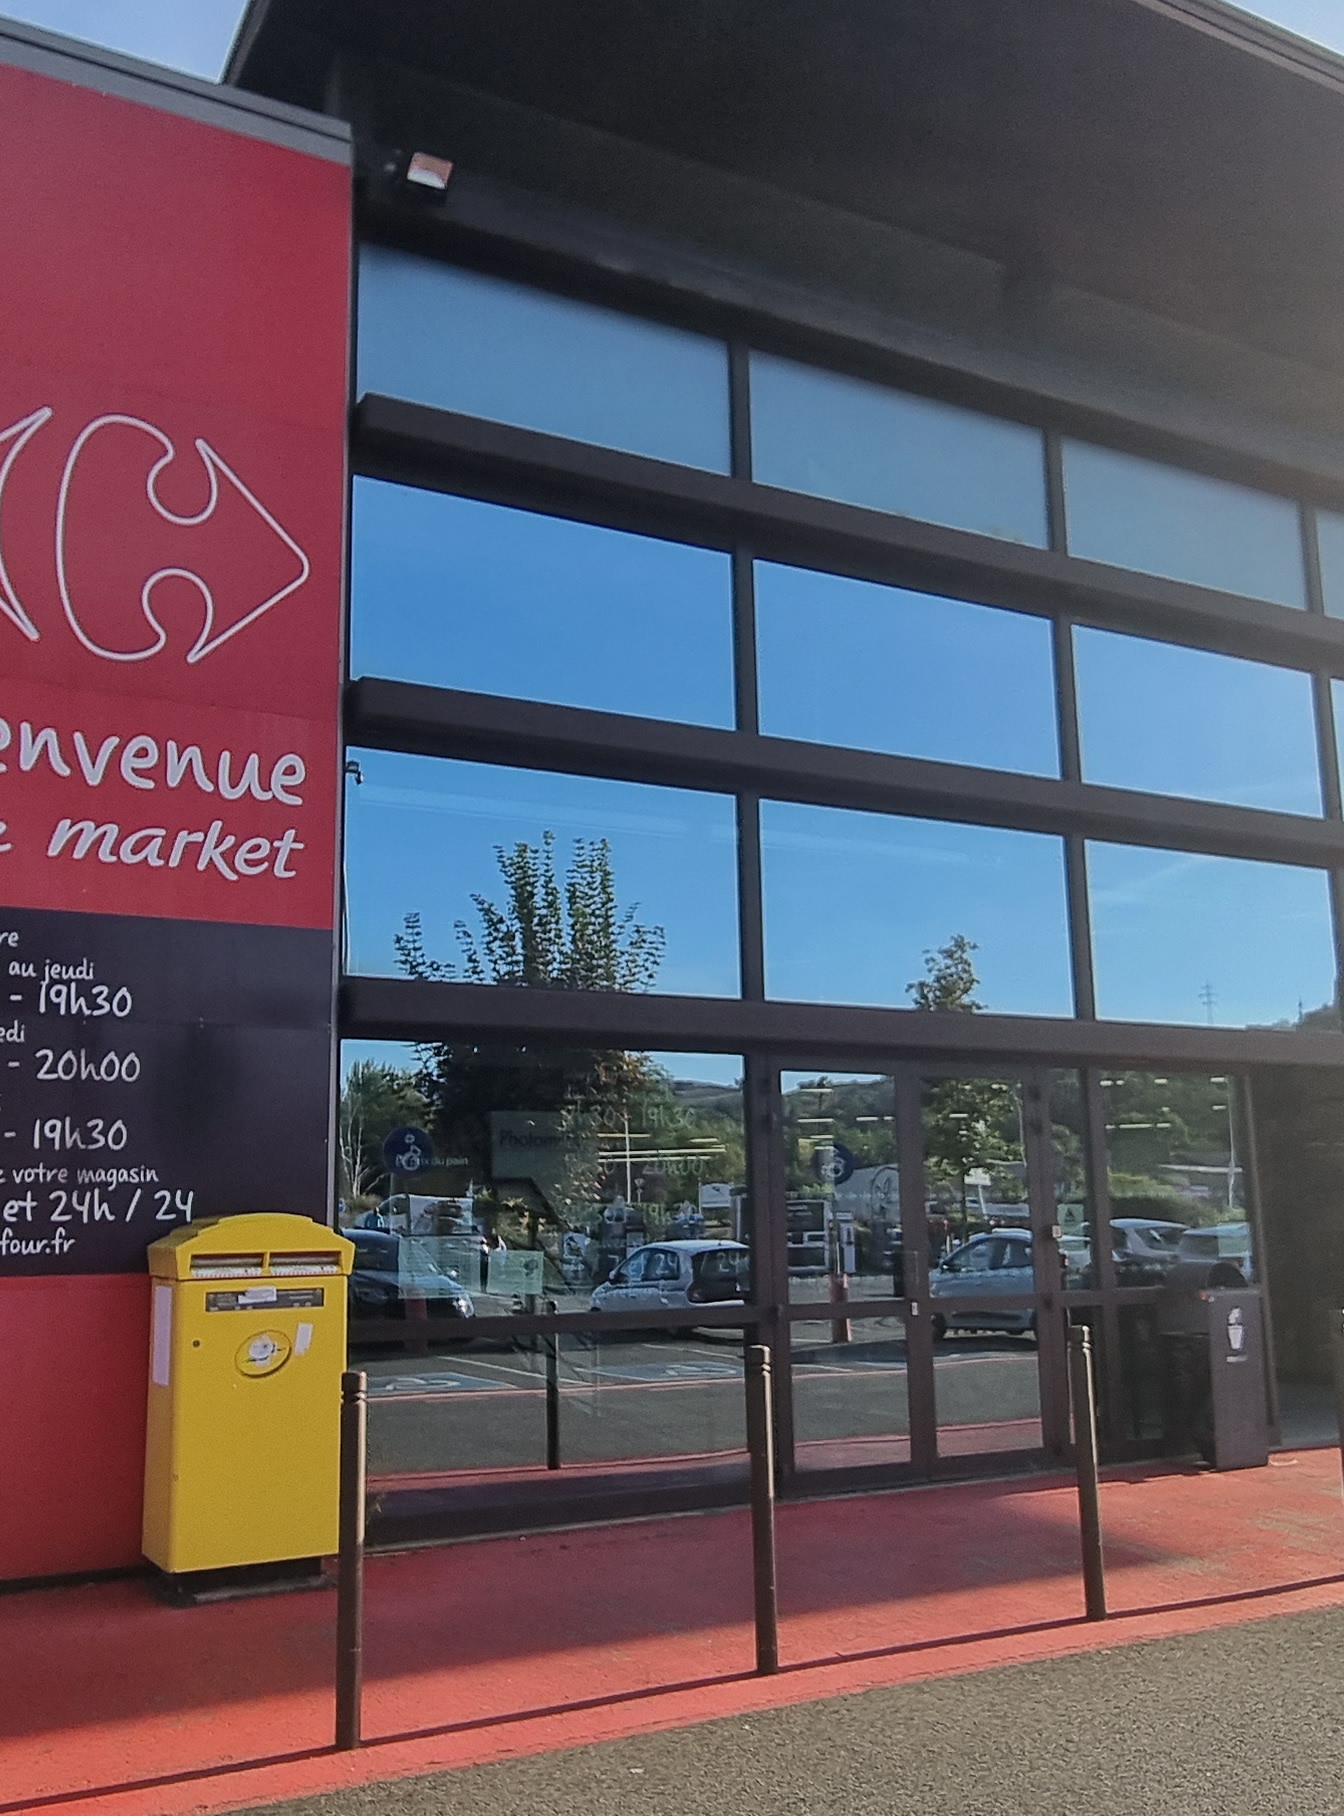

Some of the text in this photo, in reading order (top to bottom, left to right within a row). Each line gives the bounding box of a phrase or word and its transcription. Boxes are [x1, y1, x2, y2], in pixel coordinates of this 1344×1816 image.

[47, 818, 305, 881] market
[8, 960, 37, 979] au
[43, 957, 95, 984] jeudi
[39, 983, 133, 1017] 19h30
[34, 1048, 141, 1082] 20h00
[32, 1118, 128, 1151] 19h30
[12, 1164, 69, 1184] votre
[76, 1164, 159, 1191] magasin
[3, 1191, 37, 1223] et
[48, 1190, 116, 1224] 24h
[124, 1188, 142, 1223] /
[155, 1190, 194, 1223] 24
